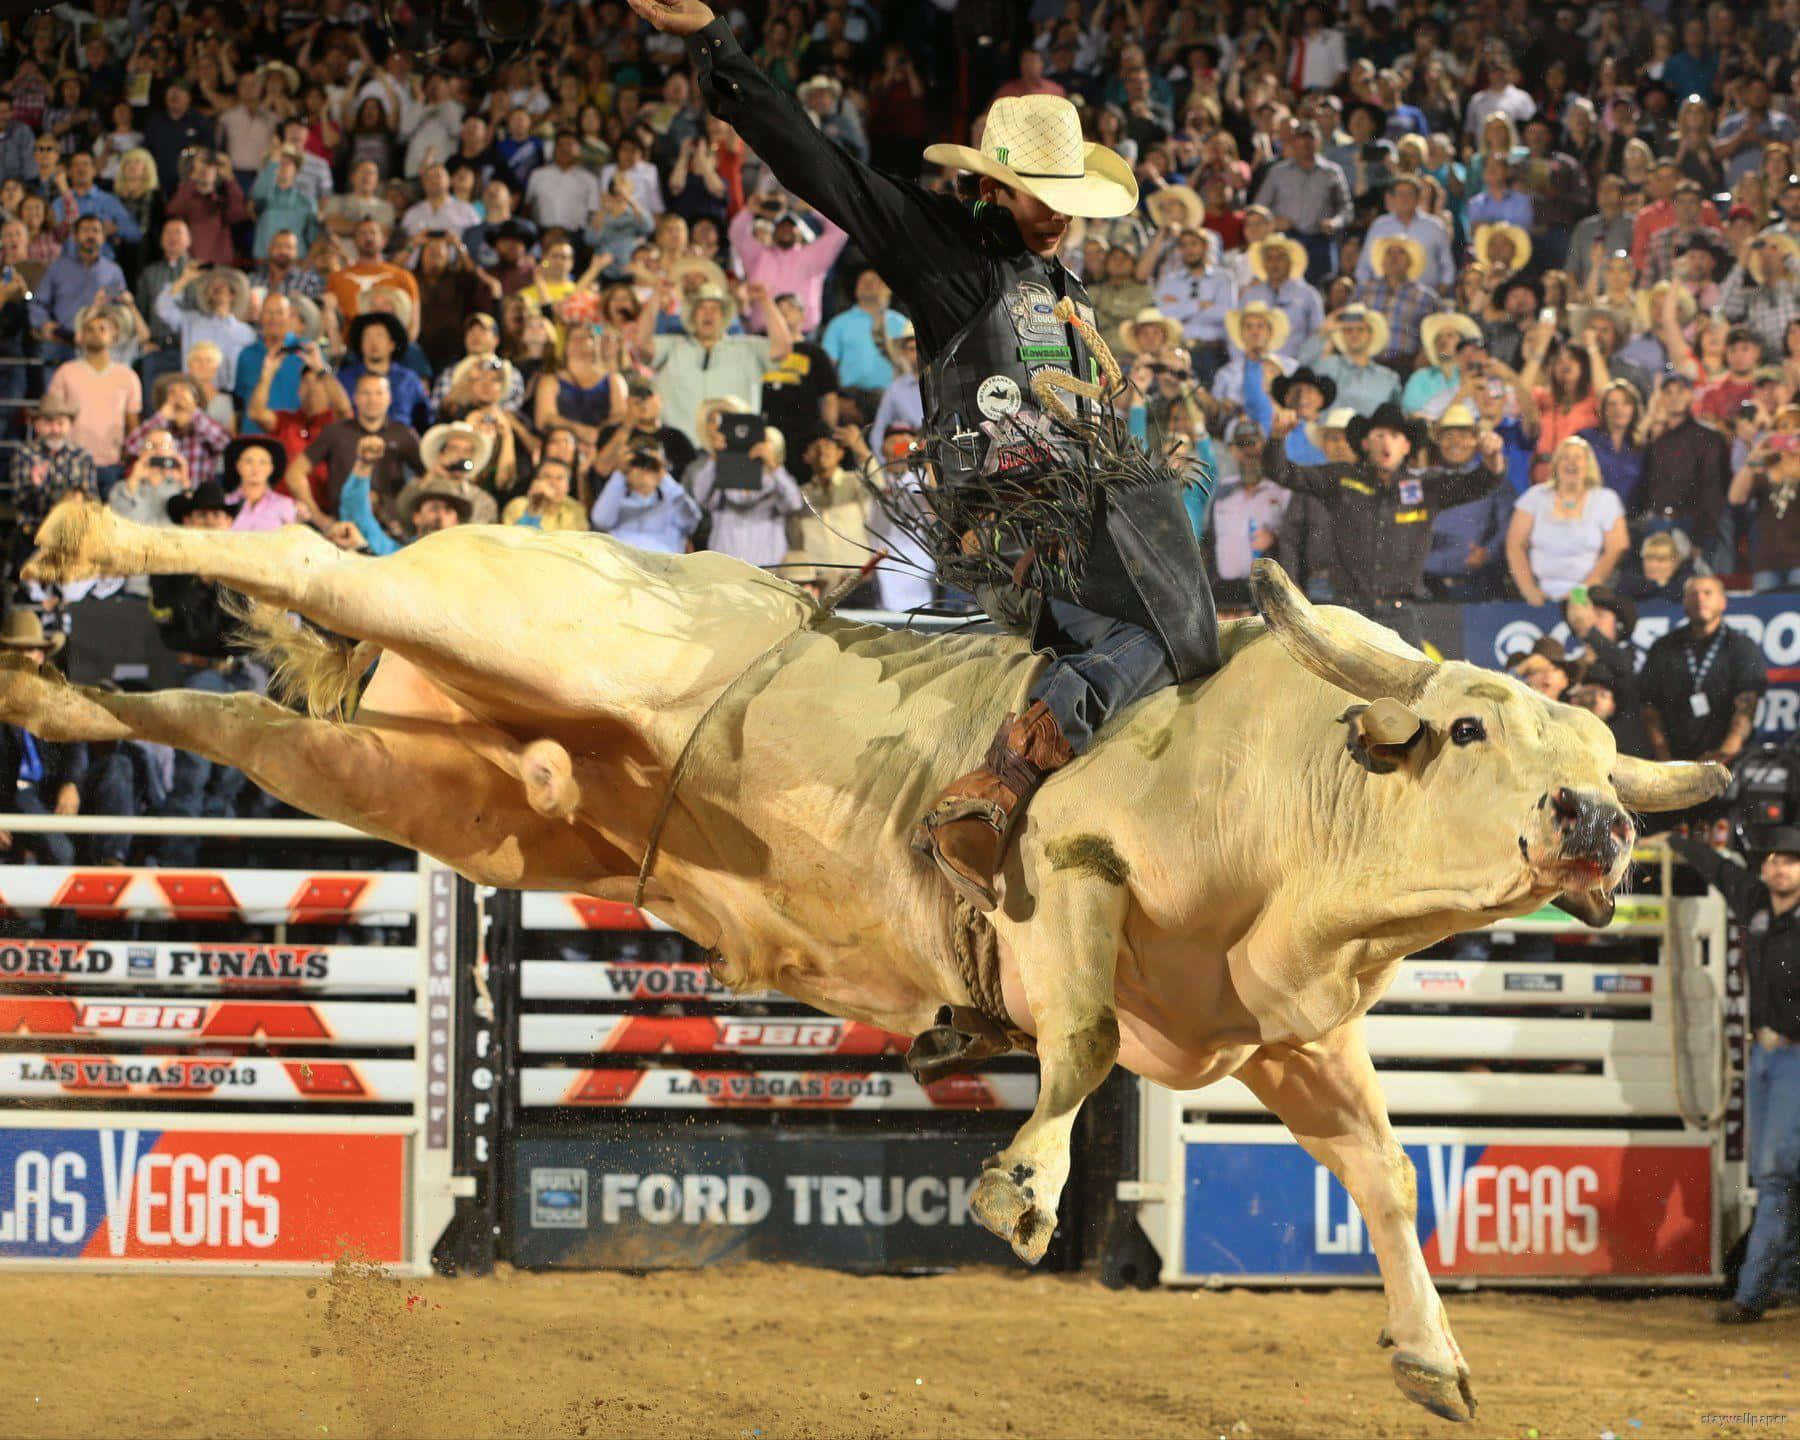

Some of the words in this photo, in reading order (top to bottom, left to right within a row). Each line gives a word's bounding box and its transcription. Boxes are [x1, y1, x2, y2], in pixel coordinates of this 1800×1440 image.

[0, 947, 113, 974] ORLD
[170, 951, 329, 979] FINALS
[605, 970, 725, 994] WORL
[82, 1006, 202, 1029] PBR
[723, 1024, 837, 1046] PBR
[20, 1062, 75, 1082] LAS
[84, 1064, 185, 1085] VEGAS
[191, 1066, 257, 1086] 2013
[668, 1077, 720, 1096] LAS
[730, 1078, 822, 1097] VEGAS
[831, 1079, 892, 1097] 2013
[99, 1129, 281, 1256] VEGAS
[602, 1174, 772, 1225] FORD
[785, 1175, 980, 1226] TRUCK
[1428, 1144, 1599, 1267] VEGAS
